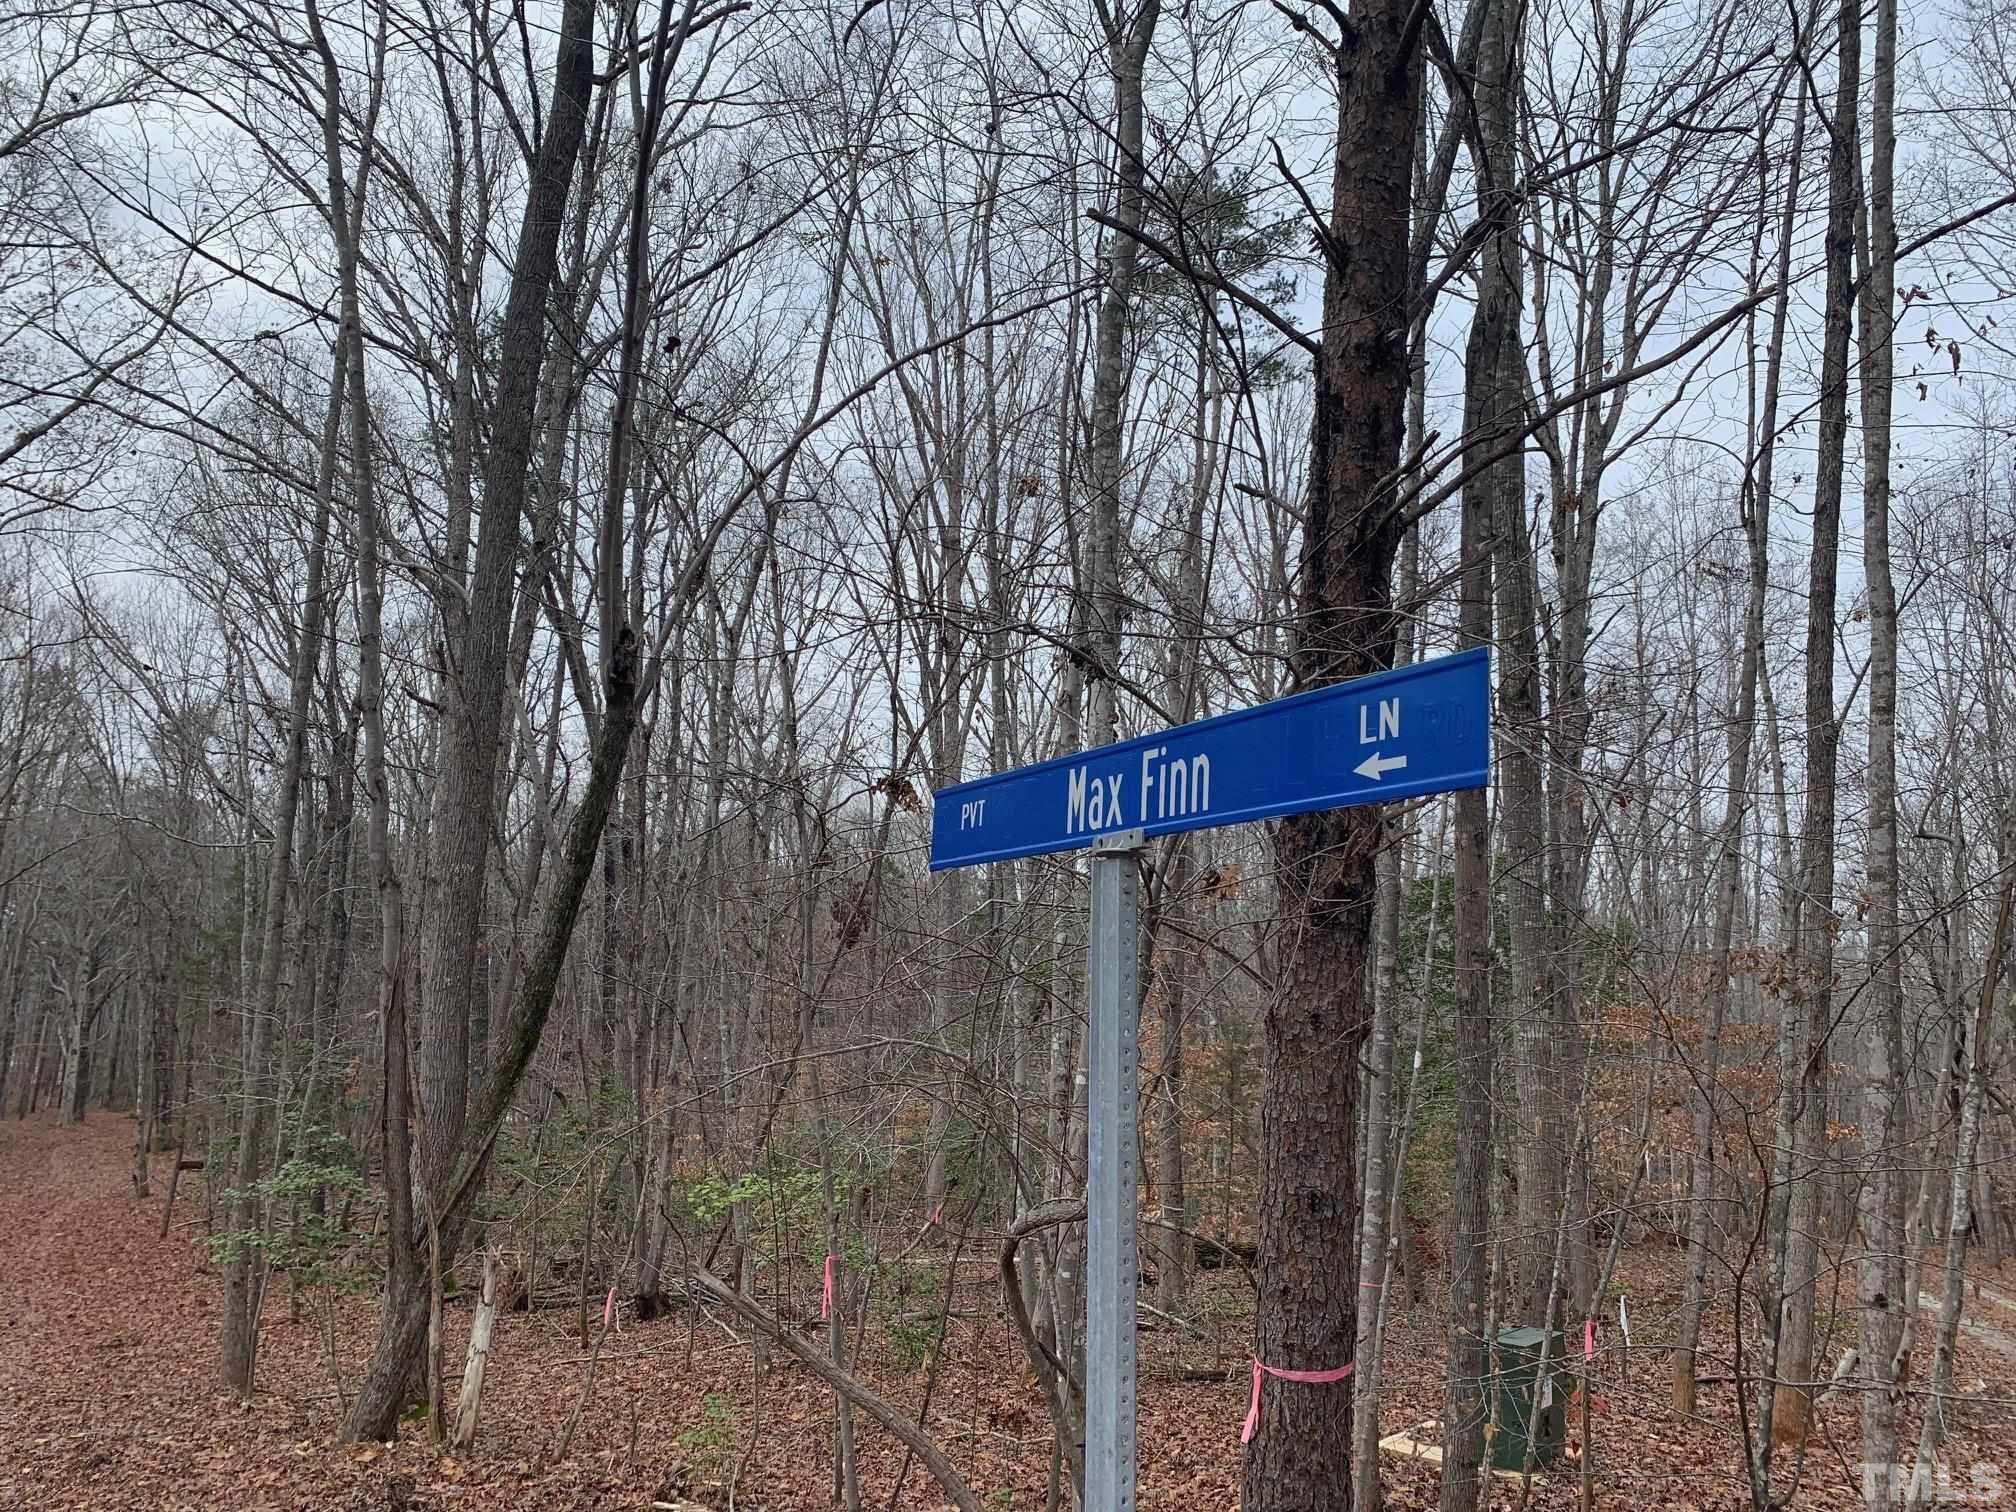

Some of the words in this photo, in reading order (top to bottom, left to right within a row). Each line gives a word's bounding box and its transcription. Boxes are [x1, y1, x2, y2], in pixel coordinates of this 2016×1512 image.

[961, 800, 986, 830] PVT
[1067, 766, 1123, 833] Max
[1141, 747, 1210, 821] Finn
[1360, 697, 1400, 744] LN
